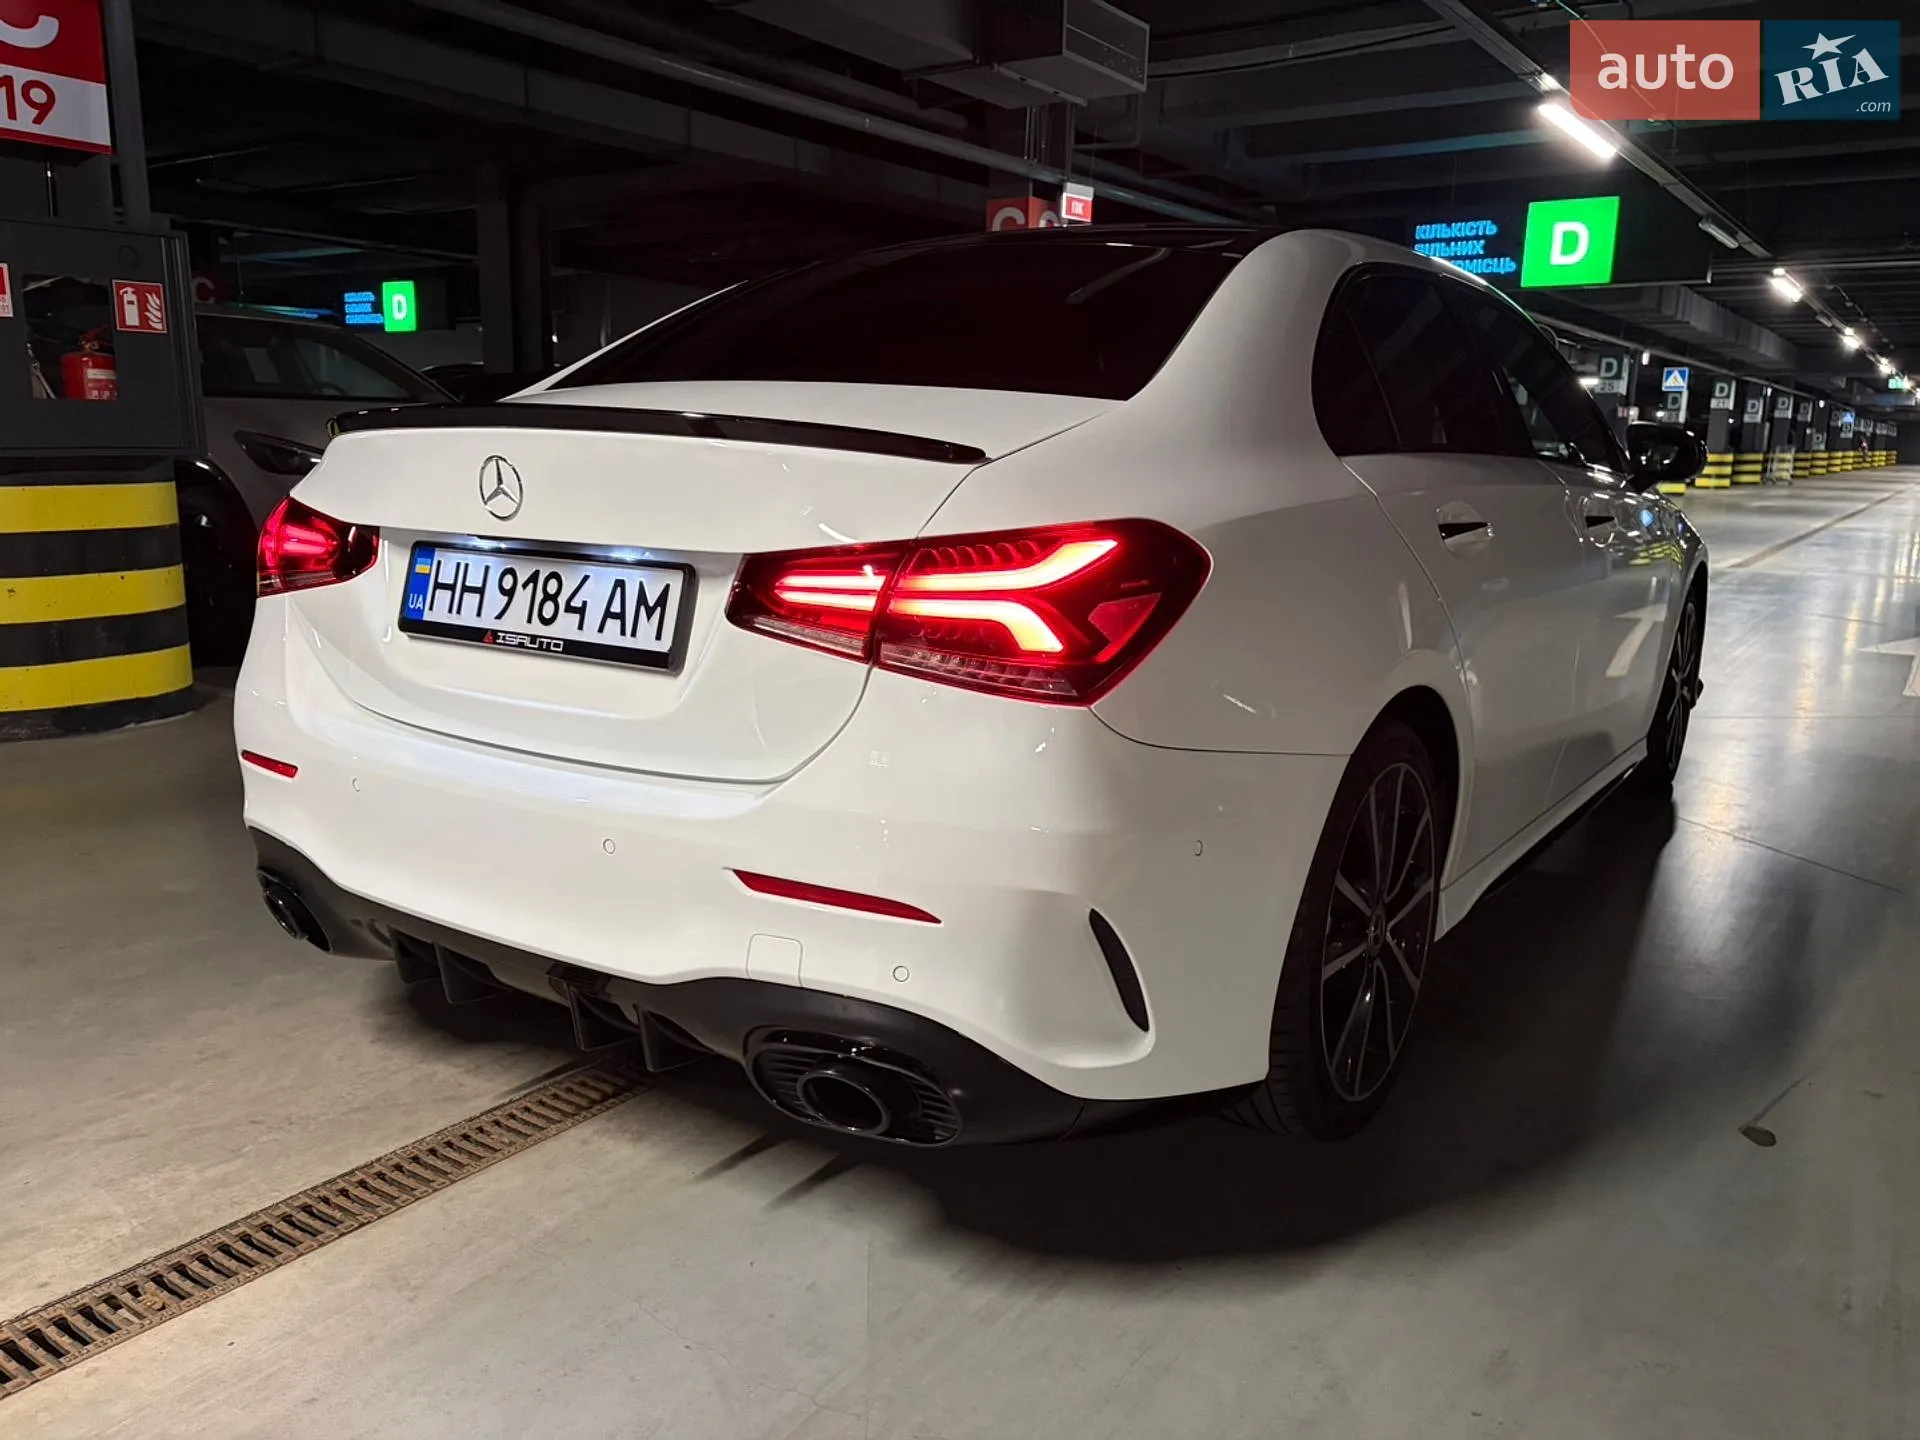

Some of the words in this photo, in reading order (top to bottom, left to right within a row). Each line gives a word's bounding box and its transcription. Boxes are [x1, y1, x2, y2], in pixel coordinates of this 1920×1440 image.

[0, 74, 56, 125] 19
[1415, 220, 1498, 240] КІЛЬКІСТЬ
[1550, 221, 1589, 265] D
[391, 293, 408, 321] D
[1600, 357, 1618, 378] D
[1714, 382, 1729, 397] D
[1667, 393, 1681, 409] D
[1747, 399, 1759, 412] D
[1777, 397, 1789, 408] D
[408, 592, 424, 610] UA
[429, 559, 490, 617] HH
[494, 566, 591, 631] 9184
[597, 578, 671, 641] AM
[496, 632, 564, 652] ISAUTO
